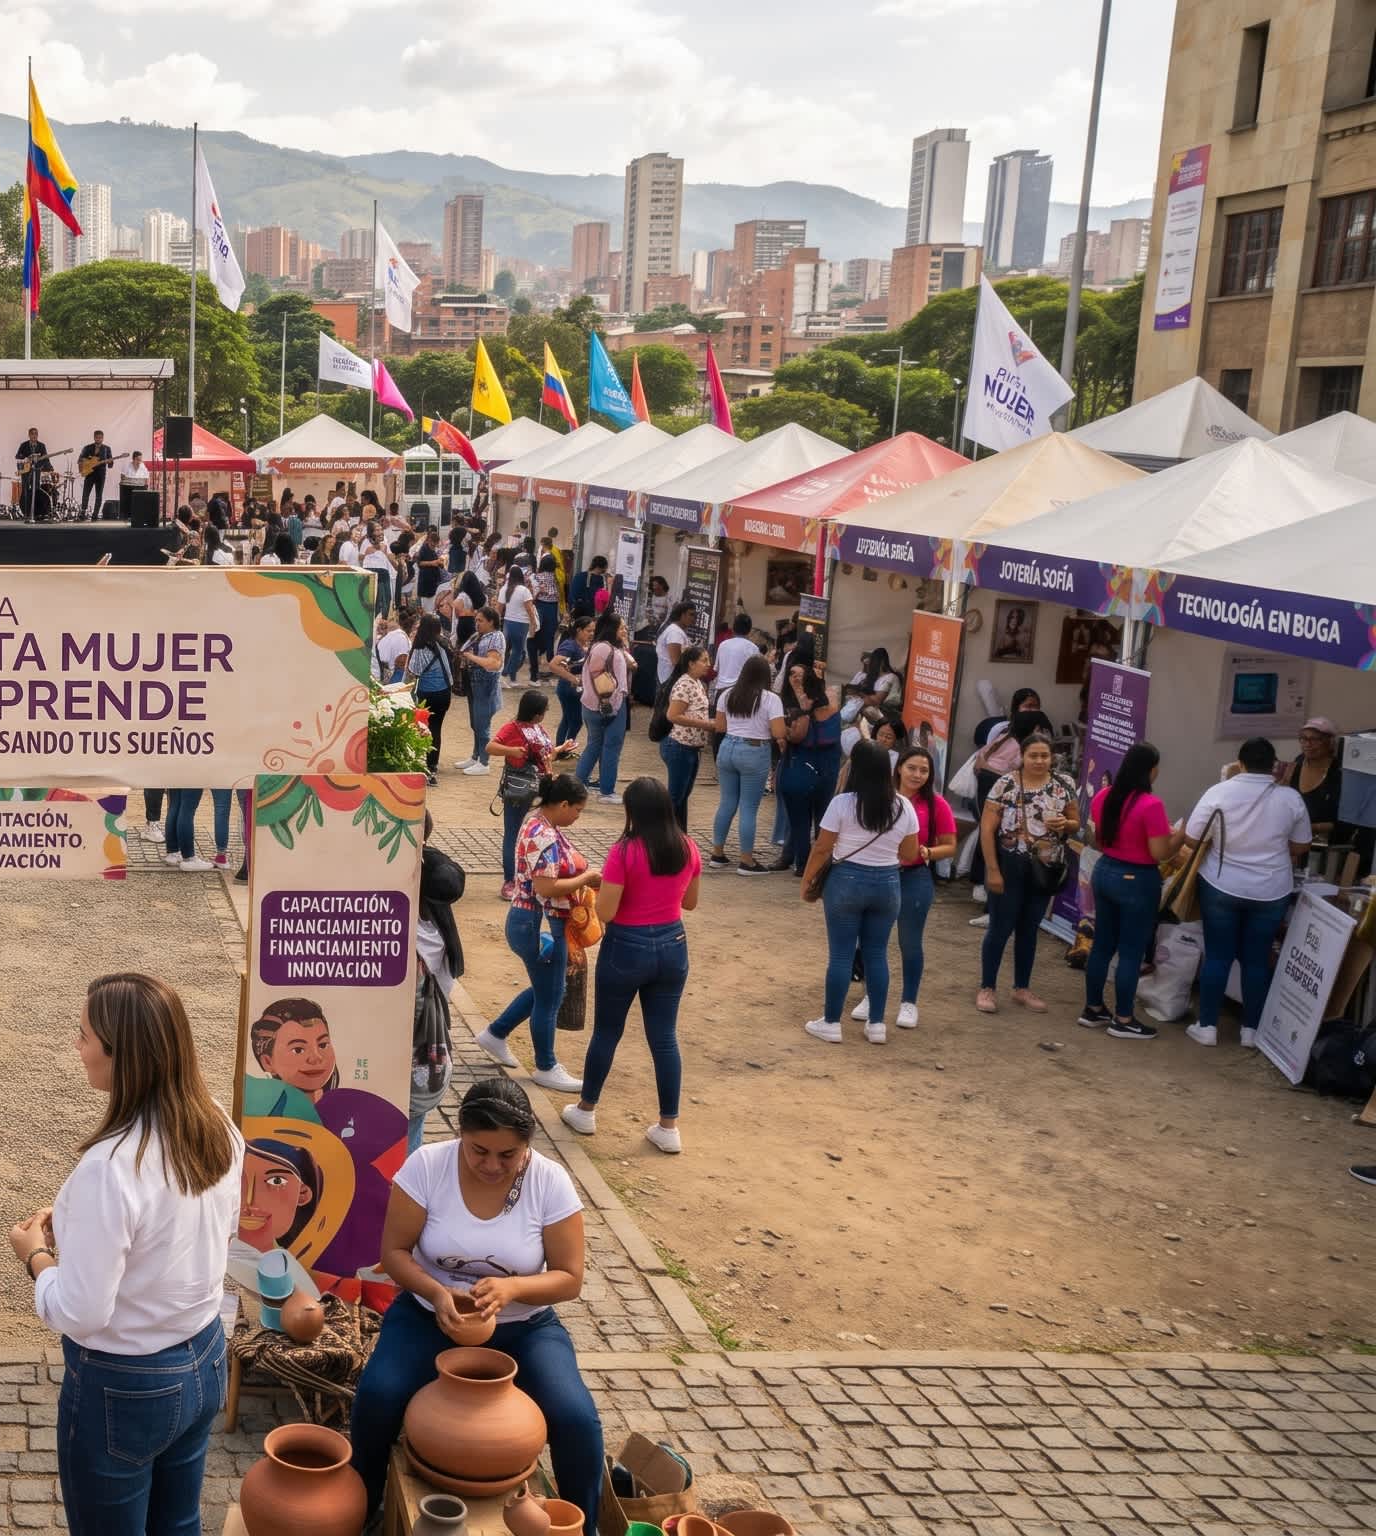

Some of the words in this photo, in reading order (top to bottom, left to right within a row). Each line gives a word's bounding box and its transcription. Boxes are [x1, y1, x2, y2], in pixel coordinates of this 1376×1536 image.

[999, 560, 1041, 586] JOYERÍA
[1042, 564, 1074, 592] SOFÍA
[1177, 592, 1265, 630] TECNOLOGÍA
[1268, 610, 1290, 635] EN
[61, 632, 234, 673] MUJER
[78, 731, 121, 755] TUS
[127, 726, 215, 756] SUEÑOS
[281, 893, 395, 914] CAPACITACIÓN,
[270, 918, 402, 936] FINANCIAMIENTO
[269, 939, 401, 957] FINANCIAMIENTO
